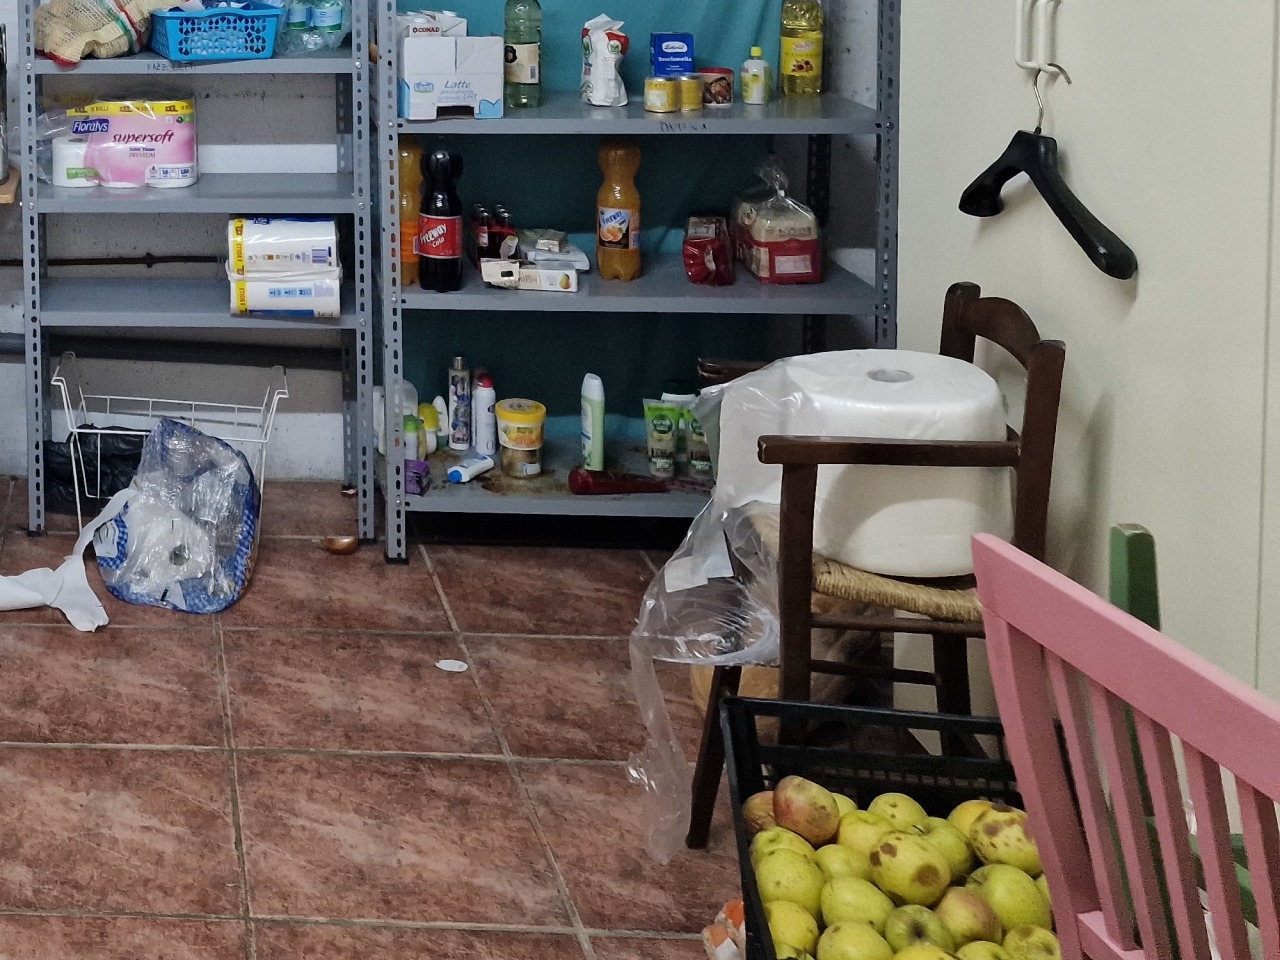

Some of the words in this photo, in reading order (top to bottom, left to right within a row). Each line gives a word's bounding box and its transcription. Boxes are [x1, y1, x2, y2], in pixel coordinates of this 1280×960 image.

[444, 80, 472, 89] Latte
[73, 121, 109, 132] Floralys
[112, 129, 175, 145] supersoft
[432, 236, 445, 248] Cola
